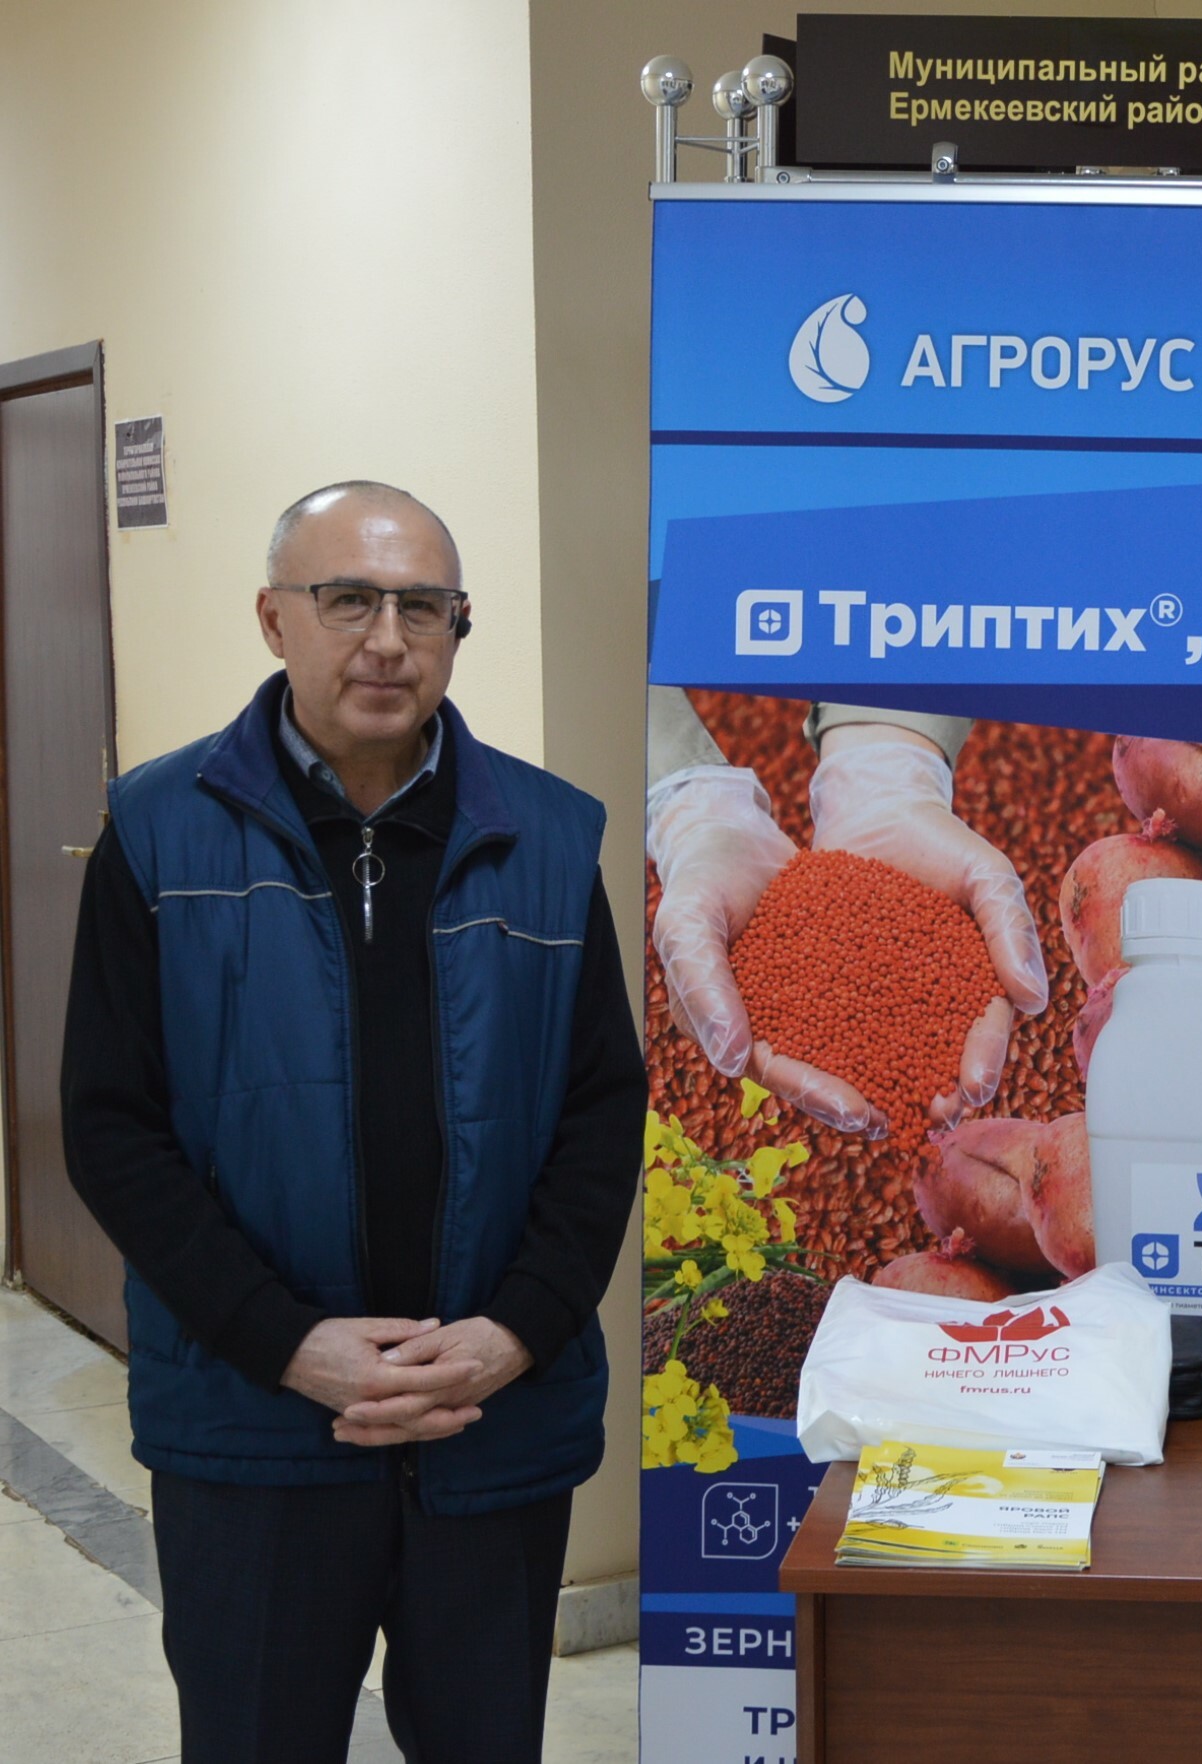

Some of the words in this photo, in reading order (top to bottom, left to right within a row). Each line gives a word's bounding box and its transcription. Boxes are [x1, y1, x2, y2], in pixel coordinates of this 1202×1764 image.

[888, 51, 1167, 86] Муниципальный
[889, 92, 1117, 127] Ермекеевский
[900, 334, 1195, 392] АГРОРУС
[928, 1344, 1071, 1364] ФМРус
[924, 1369, 985, 1379] НИЧЕГО
[993, 1367, 1070, 1378] ЛИШНЕГО
[960, 1385, 1032, 1394] fmrus.ru
